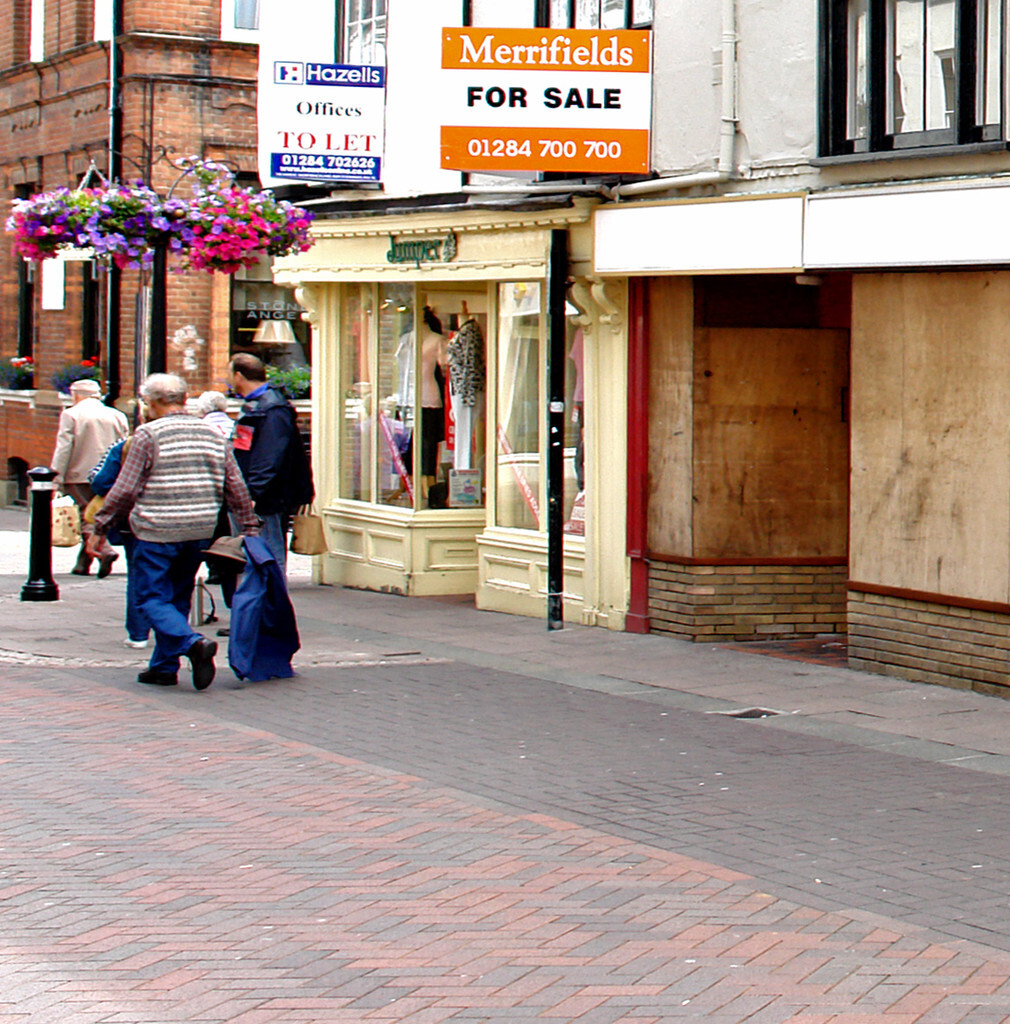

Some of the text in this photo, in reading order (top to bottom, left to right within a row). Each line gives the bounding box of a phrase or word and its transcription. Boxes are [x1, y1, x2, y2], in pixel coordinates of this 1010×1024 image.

[459, 34, 633, 66] Merrifields
[307, 65, 380, 83] Hazells
[467, 86, 621, 109] FOR SALE
[296, 101, 362, 117] Offices
[277, 131, 377, 152] TO LET
[468, 139, 621, 158] 01284 700 700
[281, 154, 376, 168] 01284 702626
[247, 310, 297, 320] ANGE
